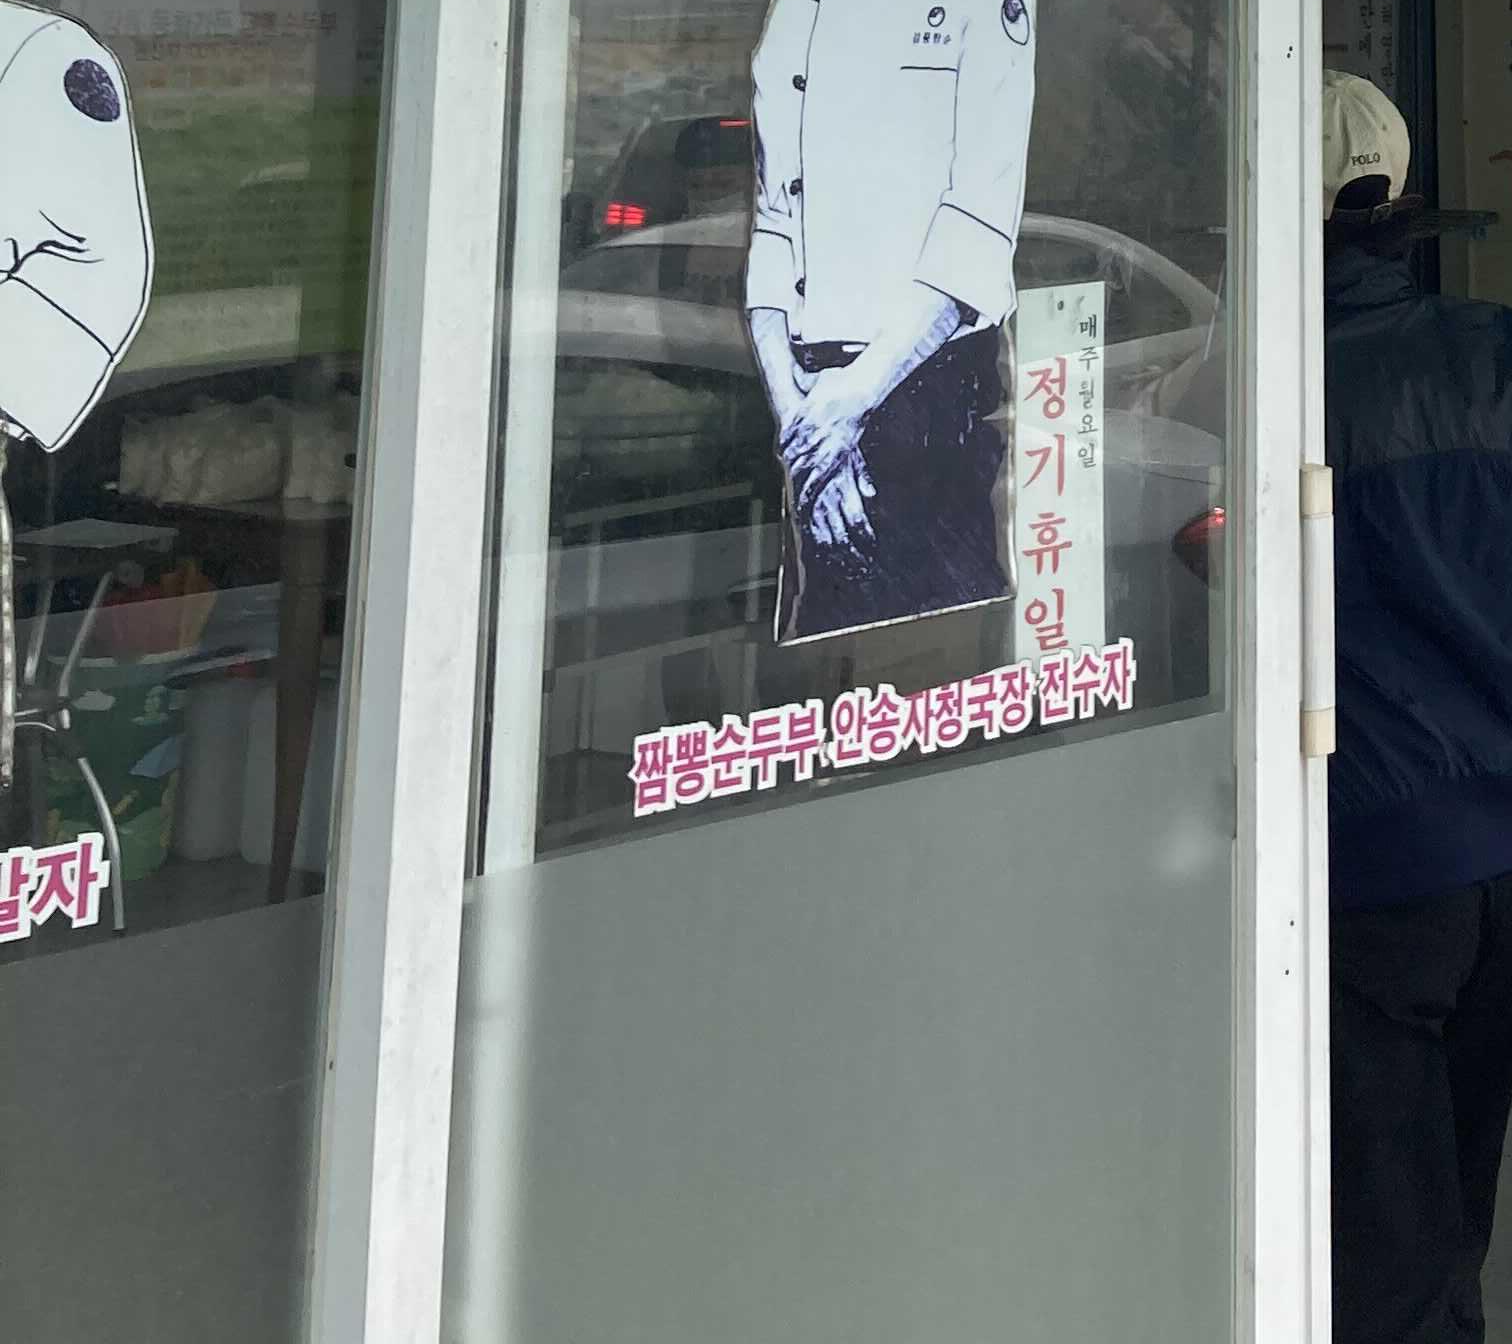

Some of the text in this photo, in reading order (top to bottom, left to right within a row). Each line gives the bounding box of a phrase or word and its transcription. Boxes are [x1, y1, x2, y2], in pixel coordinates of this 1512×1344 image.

[1351, 152, 1381, 166] POLO
[635, 645, 1132, 809] 짬뽕순두부 안송자청국장 전수자
